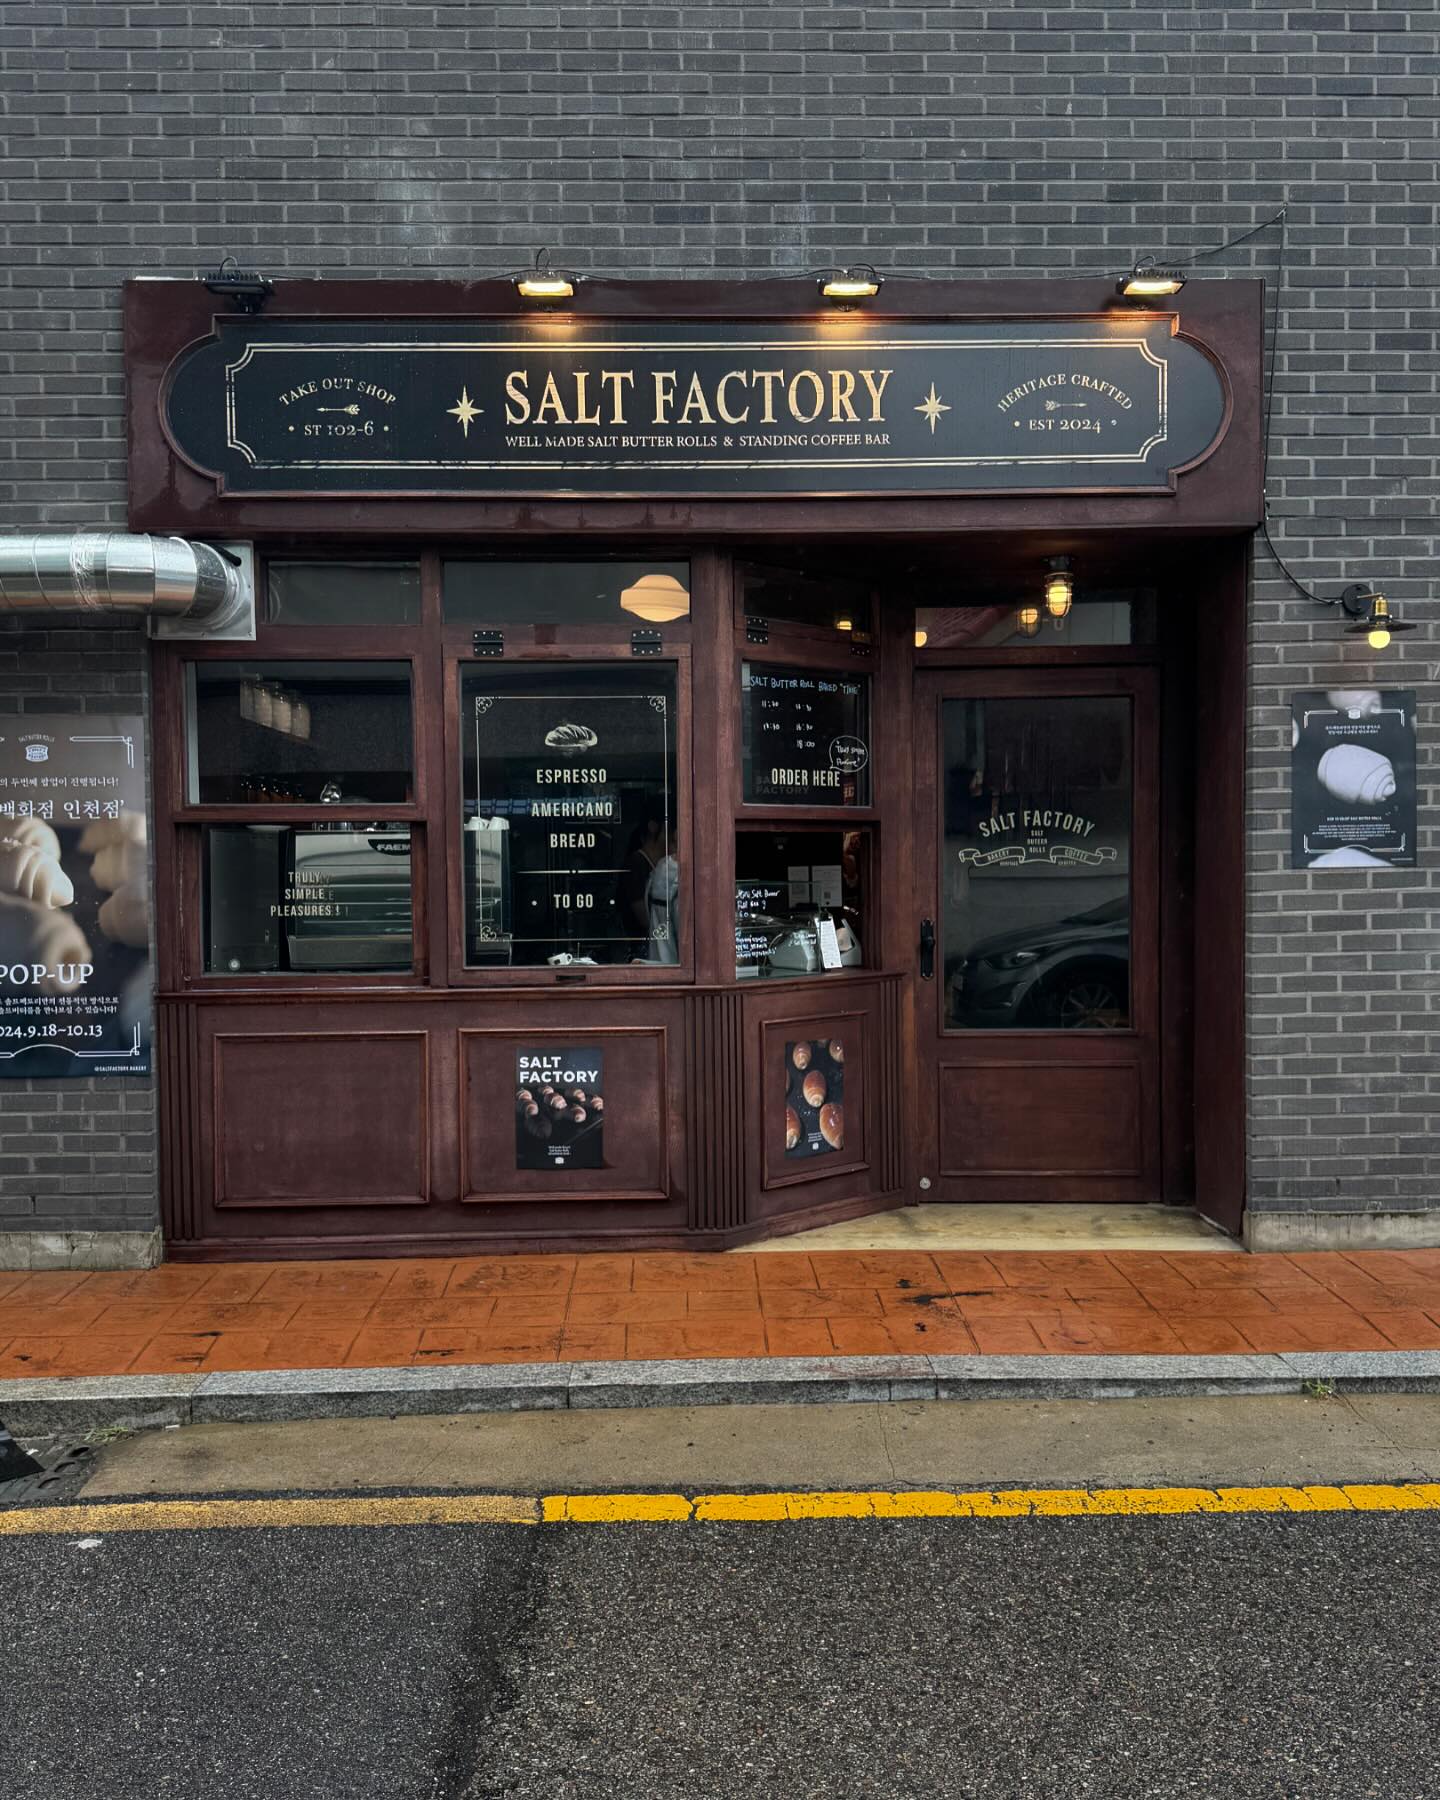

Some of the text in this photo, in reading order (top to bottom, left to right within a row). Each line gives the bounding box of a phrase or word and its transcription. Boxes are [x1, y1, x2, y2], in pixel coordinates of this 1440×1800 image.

[279, 377, 397, 406] TAKE OUT SHOP
[505, 368, 894, 426] SALT FACTORY
[997, 373, 1133, 413] HERITAGE CRAFTED
[304, 420, 374, 436] ST 102-6
[1029, 418, 1101, 434] EST 2024
[505, 433, 891, 448] WELL MADE SALT BUTTER ROLLS & STANDING COFFEE BAR
[750, 676, 768, 688] SALT
[770, 677, 799, 689] BUTTER
[800, 679, 816, 689] ROLL
[536, 768, 607, 784] ESPRESSO
[771, 767, 841, 788] ORDER HERE
[0, 799, 53, 821] 백화점
[531, 801, 613, 817] AMERICANO
[979, 810, 1095, 838] SALT FACTORY
[550, 833, 596, 849] BREAD
[987, 850, 1010, 861] BAKERY
[1064, 849, 1089, 861] COFFEE
[288, 871, 320, 884] TRULY
[284, 888, 325, 900] SIMPLE
[553, 893, 594, 909] TO GO
[270, 904, 331, 917] PLEASURES
[0, 963, 94, 985] POP-UP
[519, 1056, 562, 1068] SALT
[519, 1070, 599, 1083] FACTORY
